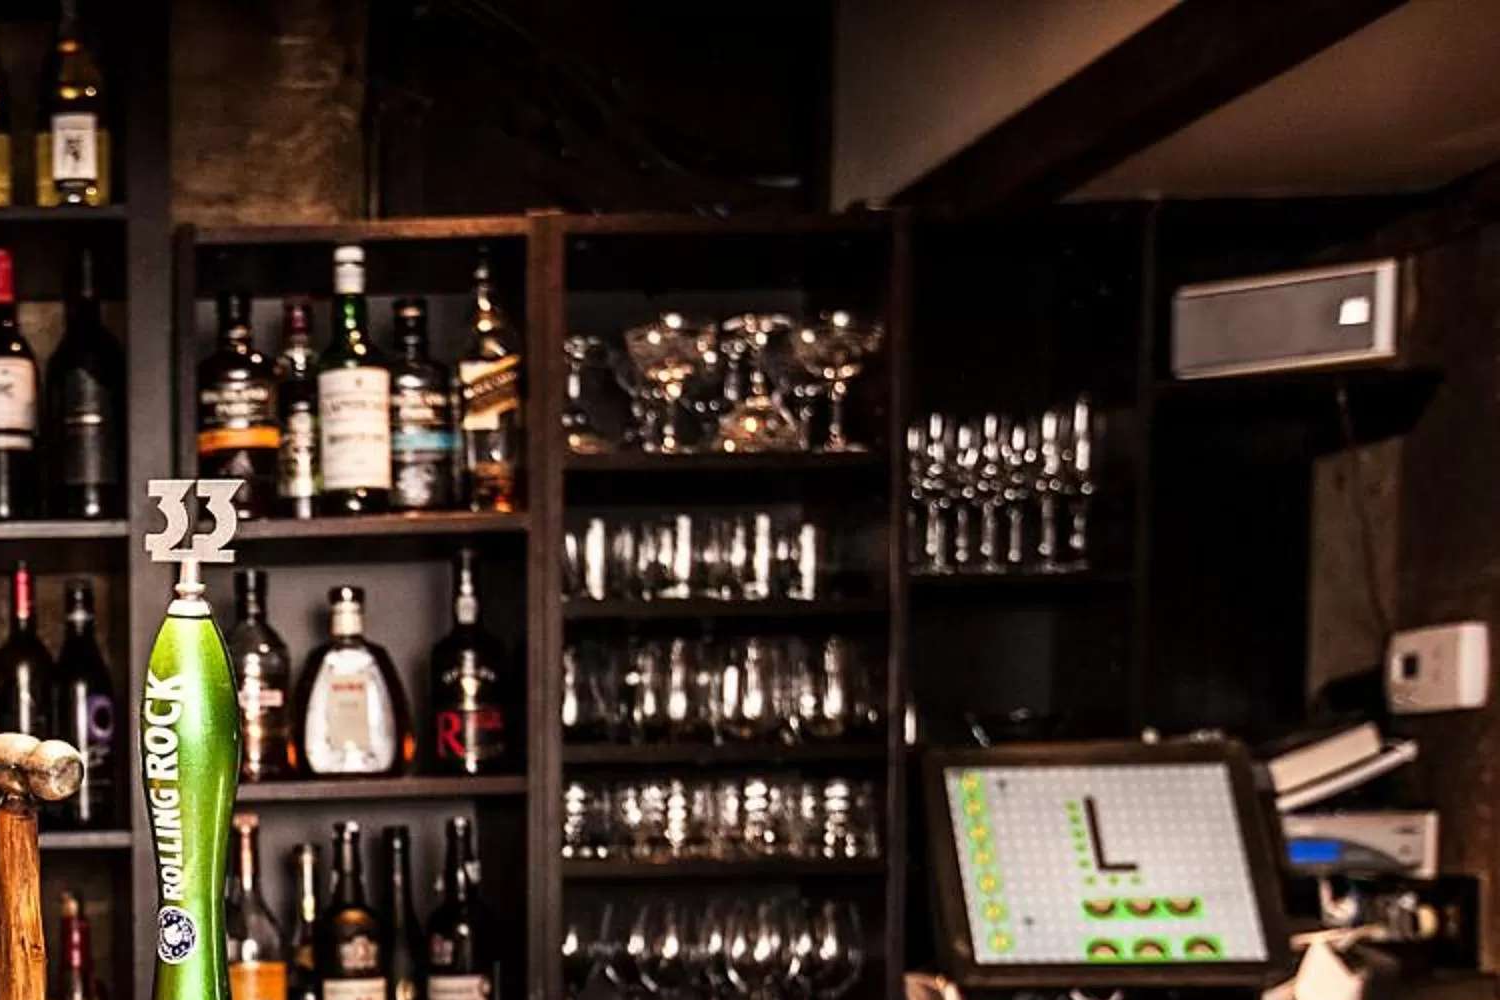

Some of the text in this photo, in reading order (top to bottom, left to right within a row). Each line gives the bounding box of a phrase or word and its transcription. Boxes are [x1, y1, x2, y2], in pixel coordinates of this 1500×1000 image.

[145, 479, 245, 562] 33
[145, 667, 183, 780] ROCK
[150, 787, 184, 901] ROLLING
